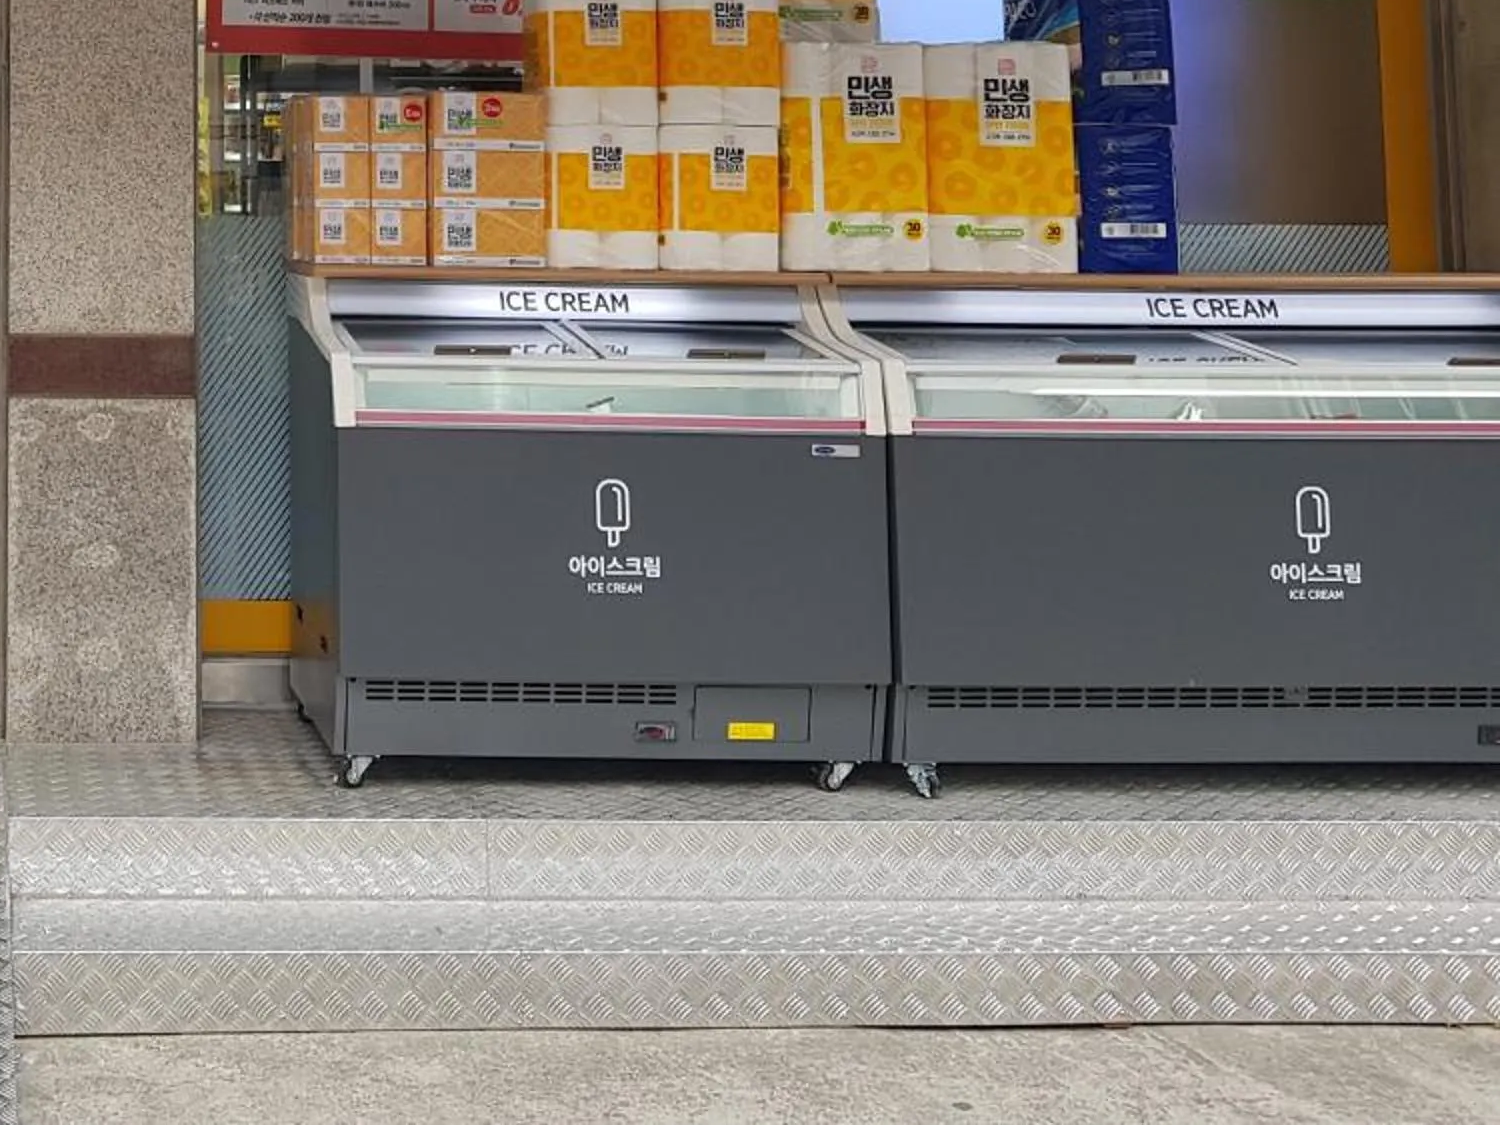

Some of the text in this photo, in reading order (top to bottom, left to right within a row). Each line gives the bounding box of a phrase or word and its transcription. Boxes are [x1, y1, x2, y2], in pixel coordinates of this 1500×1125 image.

[587, 2, 619, 18] 민생
[714, 2, 745, 18] 민생
[847, 76, 893, 100] 민생
[983, 78, 1030, 103] 민생
[848, 101, 895, 117] 화장지
[984, 104, 1031, 120] 화장지
[592, 146, 623, 162] 민생
[714, 146, 745, 163] 민생
[500, 291, 630, 315] ICE CREAM
[1147, 298, 1280, 320] ICE CREAM
[568, 555, 662, 578] 아이스크림
[1269, 563, 1362, 585] 아이스크림
[587, 583, 643, 594] ICE CREAM
[1288, 589, 1345, 600] ICE CREAM
